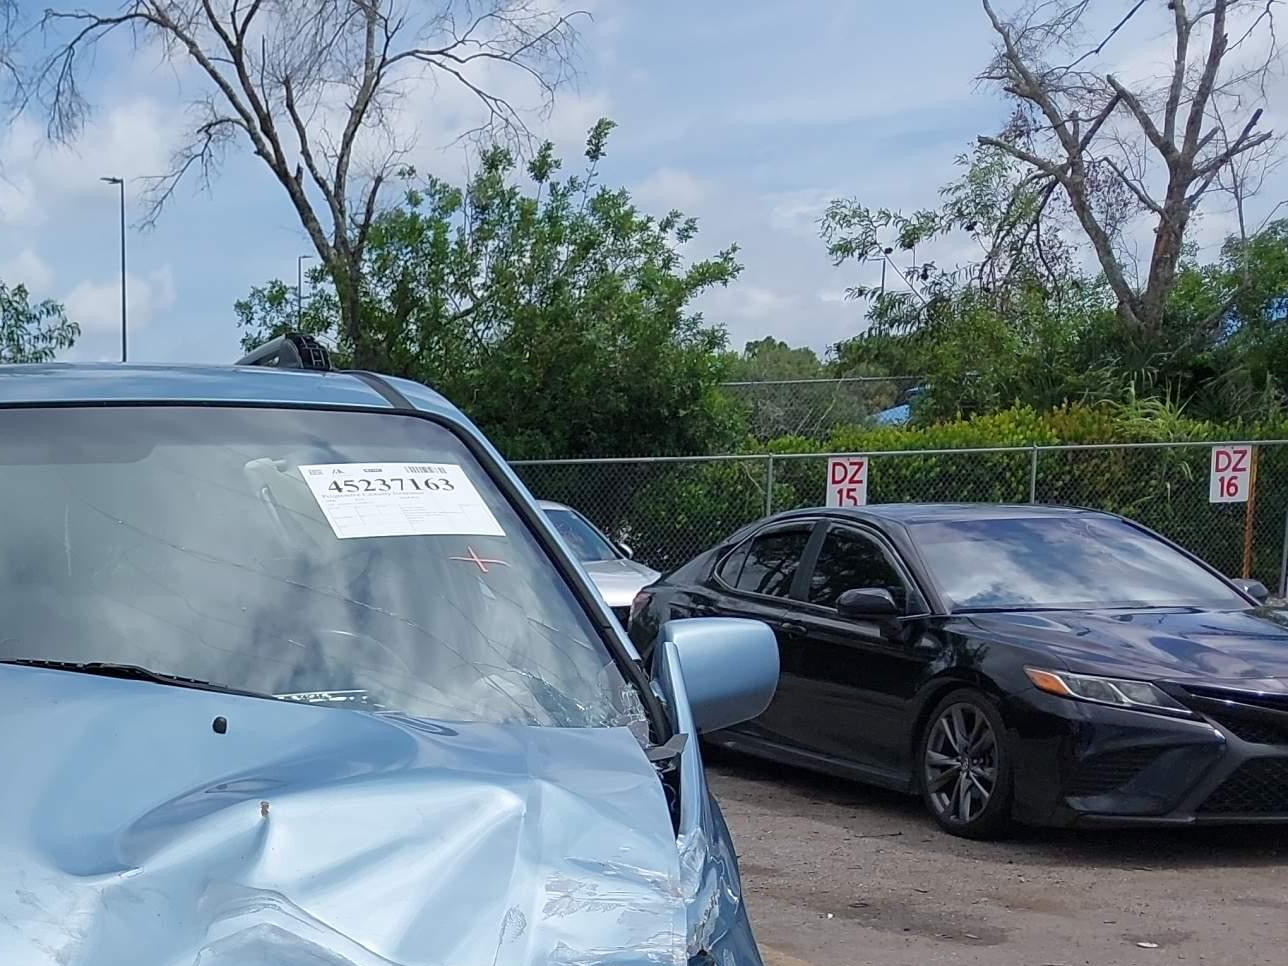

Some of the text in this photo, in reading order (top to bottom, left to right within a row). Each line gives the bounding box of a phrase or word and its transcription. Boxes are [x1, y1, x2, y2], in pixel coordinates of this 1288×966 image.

[1215, 449, 1248, 473] DZ
[831, 461, 865, 485] DZ
[328, 478, 455, 493] 45237163
[837, 487, 858, 507] 15
[1218, 475, 1239, 498] 16
